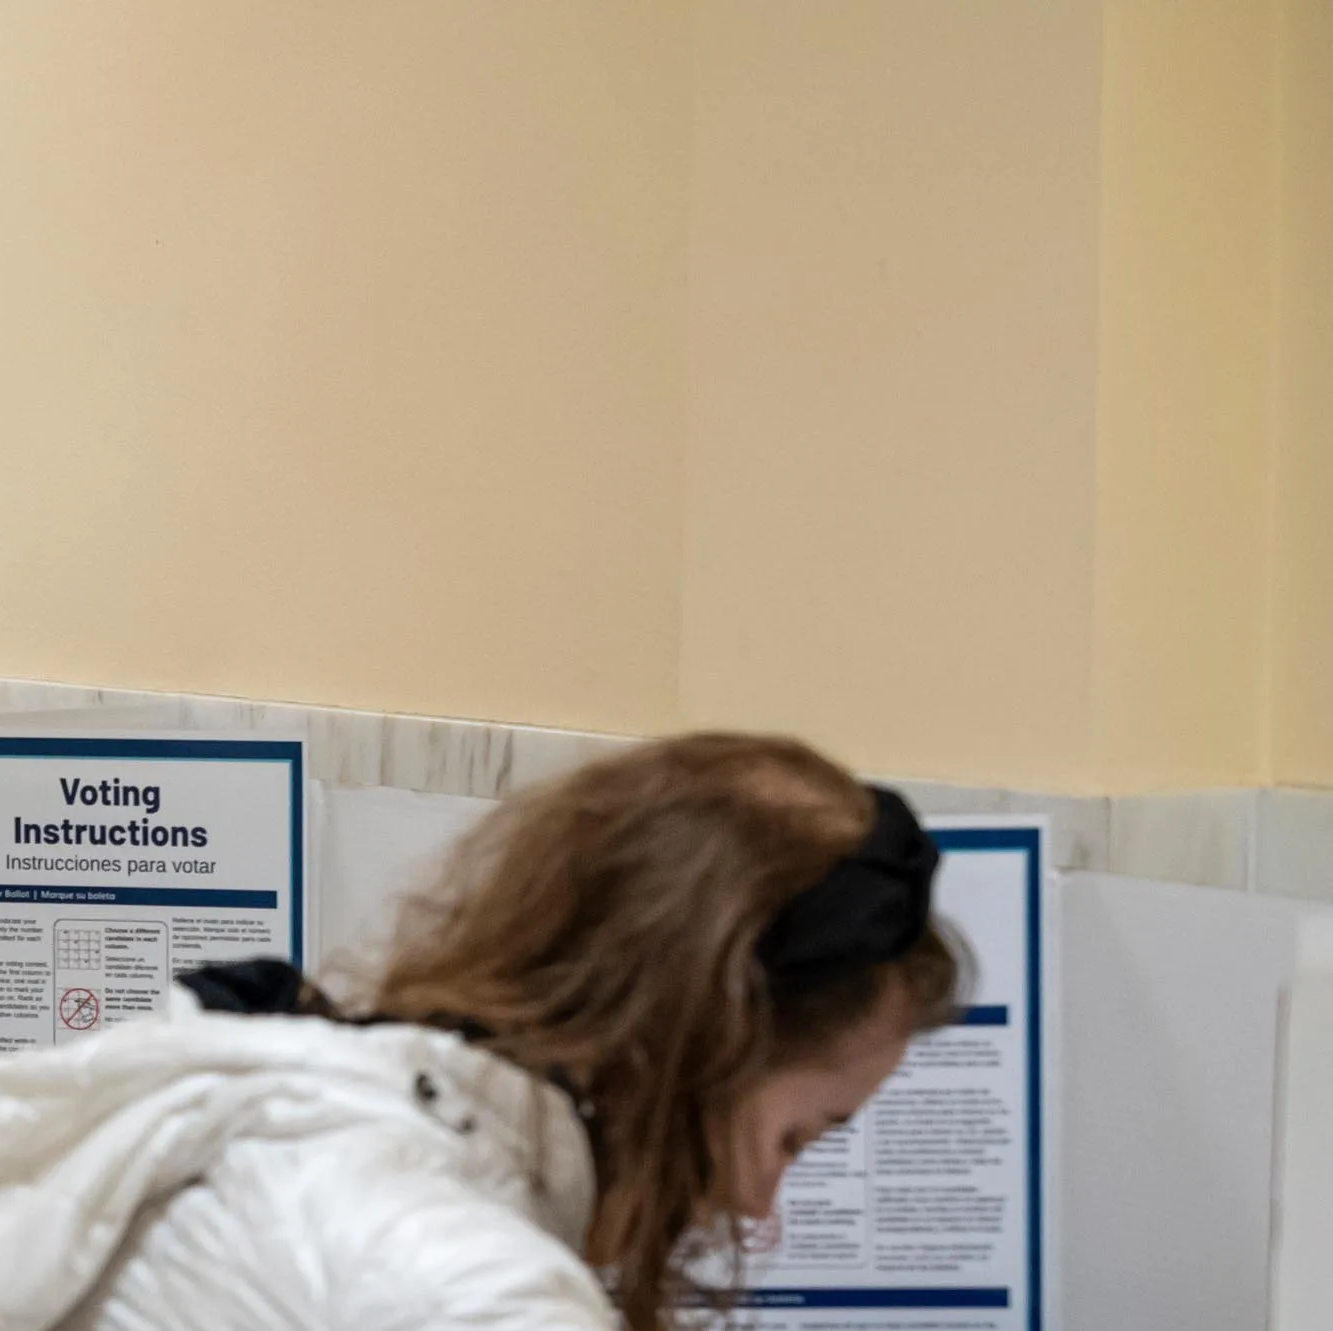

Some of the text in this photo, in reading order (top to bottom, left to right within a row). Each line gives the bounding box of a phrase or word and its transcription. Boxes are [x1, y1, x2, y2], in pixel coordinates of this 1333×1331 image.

[60, 778, 161, 813] Voting
[14, 817, 208, 848] Instructions
[6, 854, 217, 876] Instrucciones para votar
[5, 889, 30, 898] Ballot
[40, 891, 74, 901] Marque
[87, 891, 116, 901] boleta
